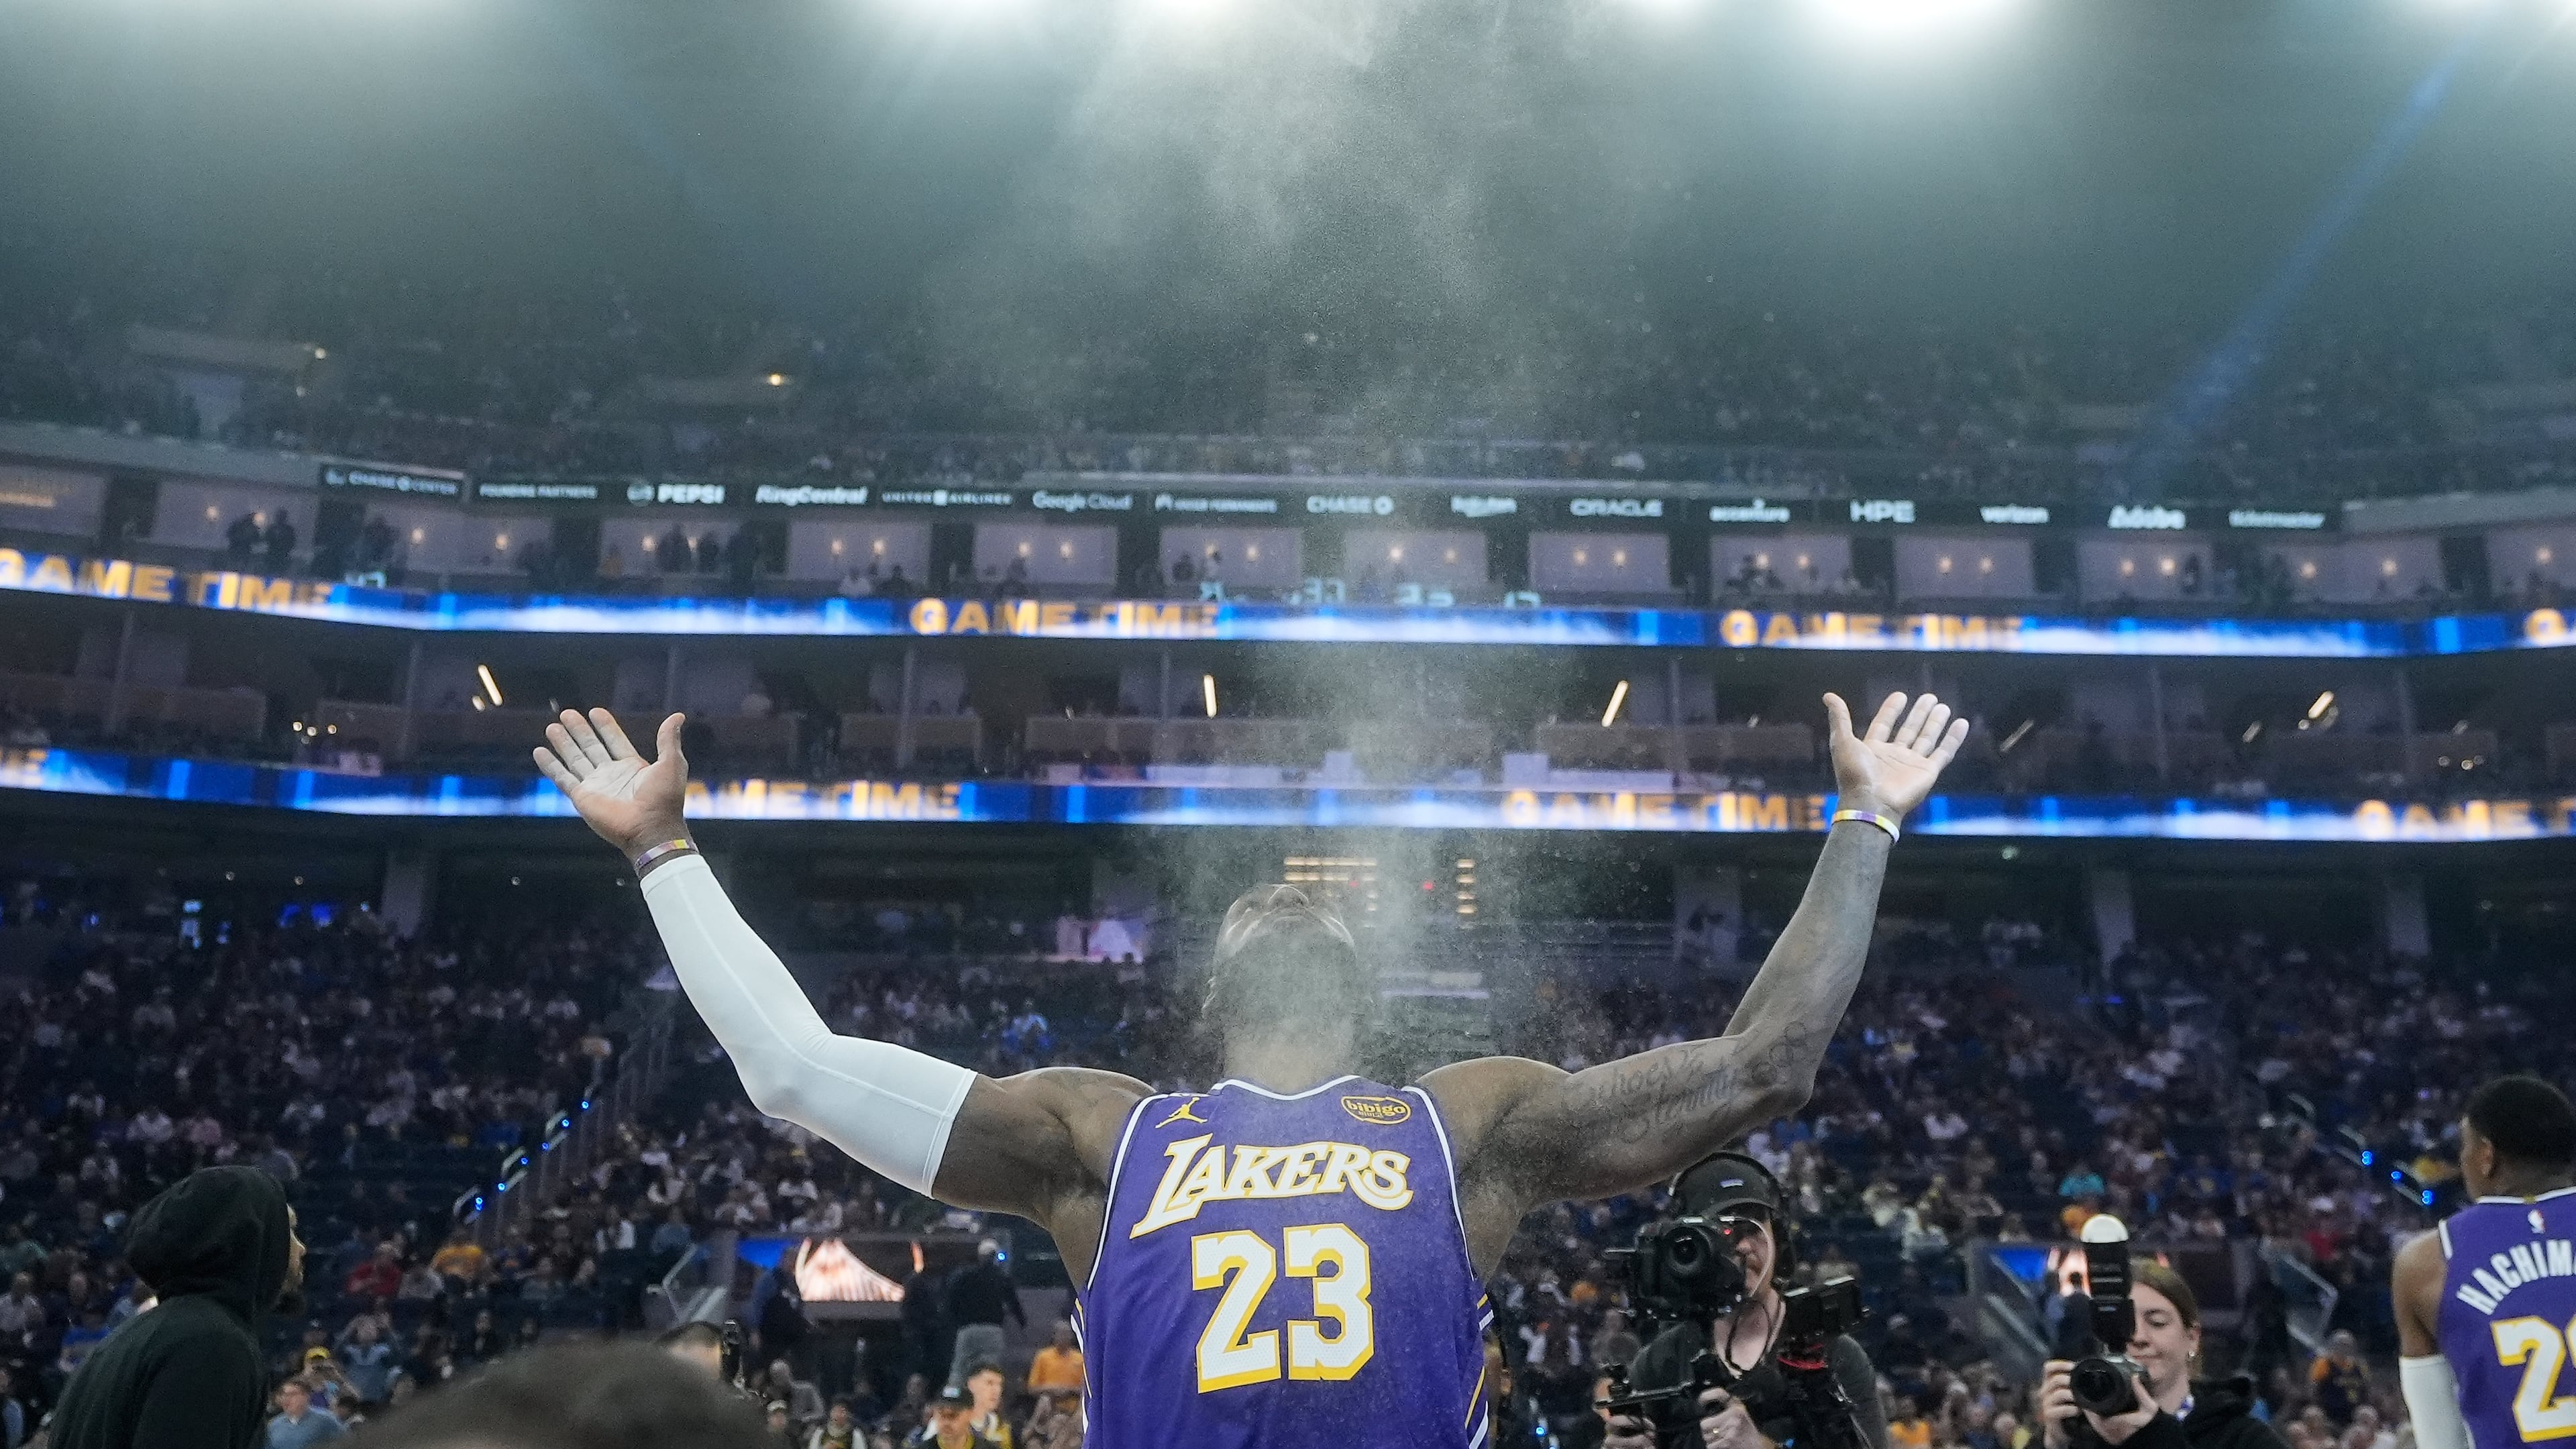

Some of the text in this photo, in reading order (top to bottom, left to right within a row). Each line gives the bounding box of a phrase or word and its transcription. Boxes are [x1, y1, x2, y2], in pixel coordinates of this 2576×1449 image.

[658, 484, 725, 504] PEPSI
[755, 485, 869, 506] RingCentral
[1033, 490, 1132, 511] Google Cloud
[1570, 498, 1663, 517] ORACLE
[1850, 500, 1917, 523] HPE
[1980, 505, 2050, 525] verizon
[2108, 505, 2187, 529] Adobe
[1346, 1099, 1407, 1117] bibigo
[1129, 1132, 1413, 1240] LAKERS
[2456, 1239, 2576, 1316] HACHIM
[1191, 1222, 1375, 1395] 23
[2489, 1315, 2576, 1443] 2
